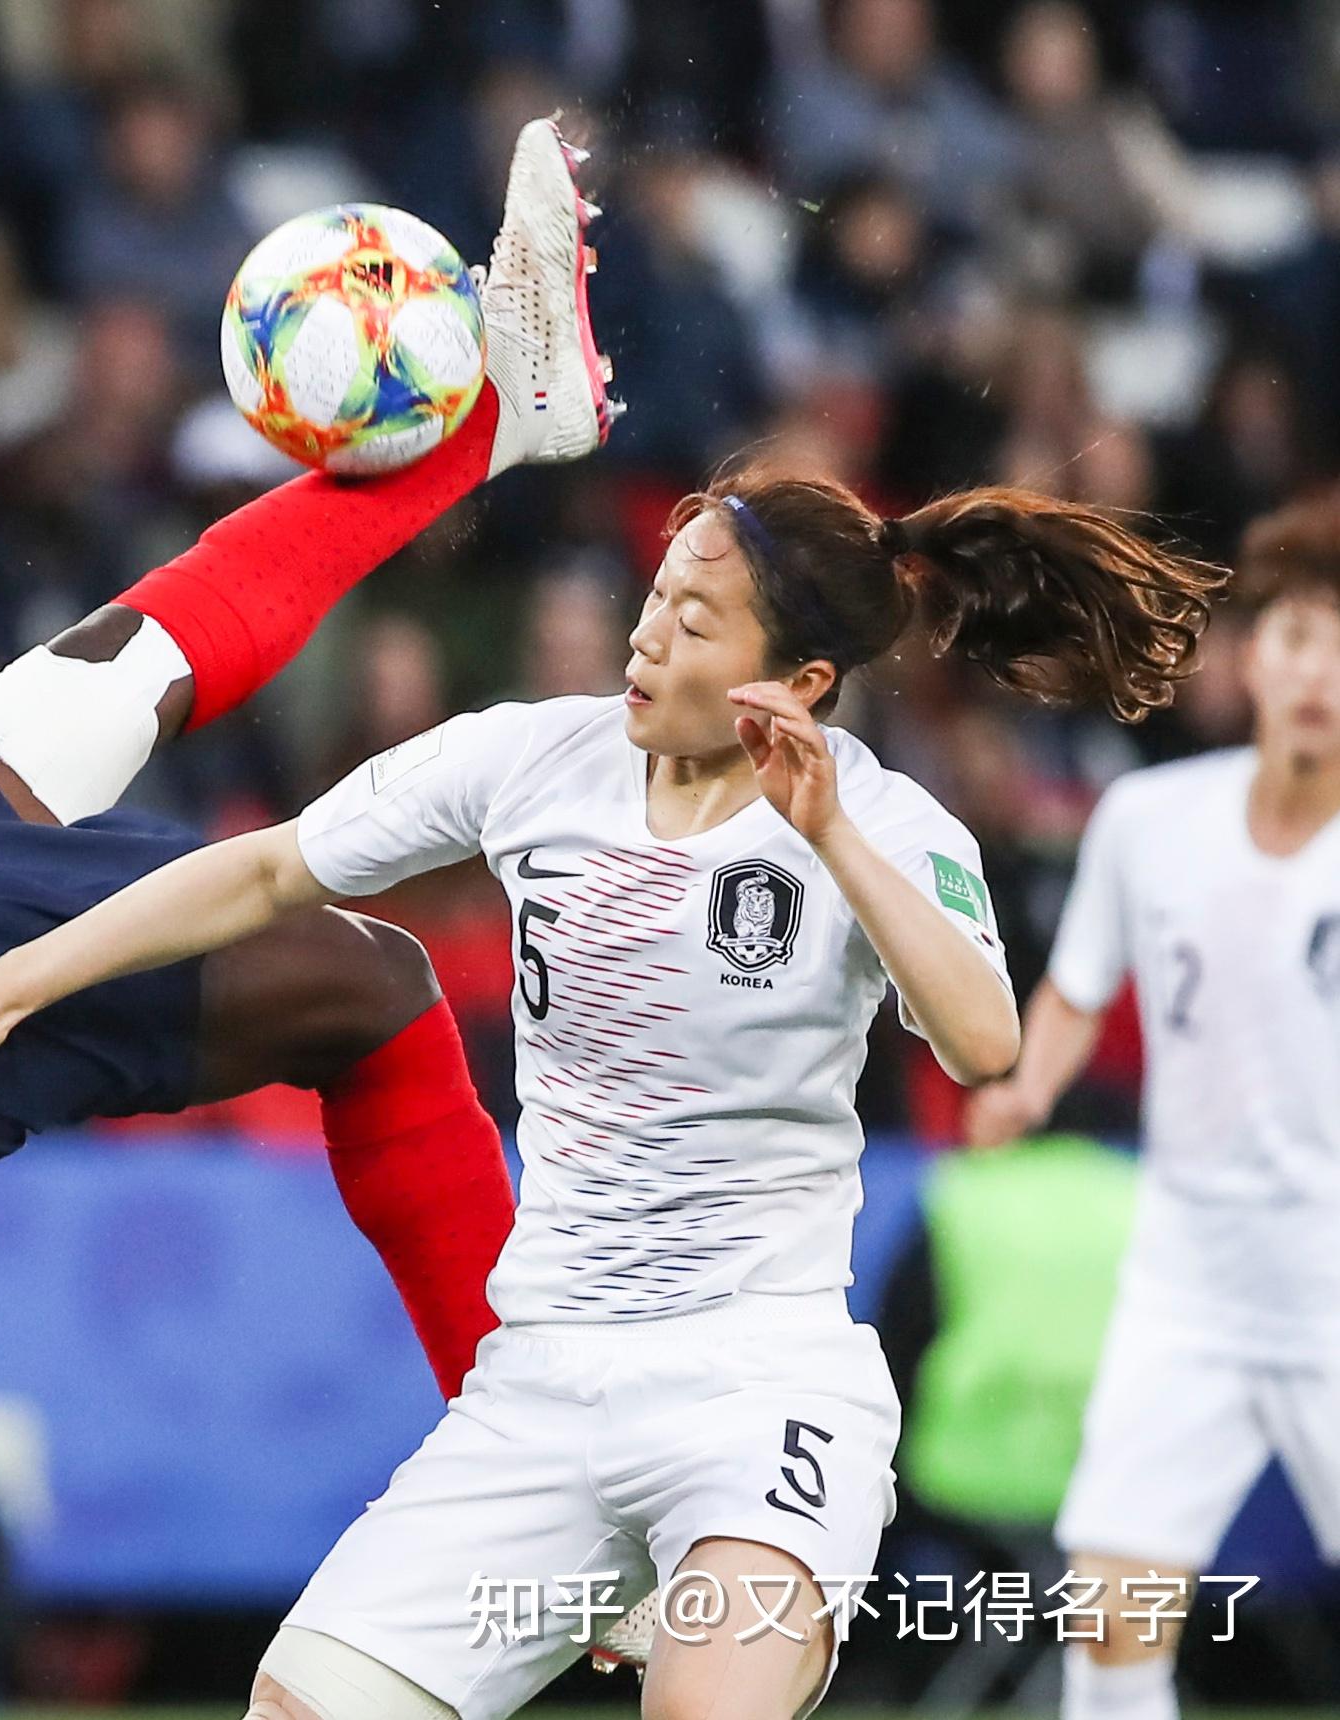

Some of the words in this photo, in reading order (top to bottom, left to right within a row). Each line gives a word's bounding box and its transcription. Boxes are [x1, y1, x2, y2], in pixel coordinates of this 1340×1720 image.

[519, 897, 561, 1021] 5
[720, 973, 774, 990] KOREA
[780, 1418, 835, 1509] 5
